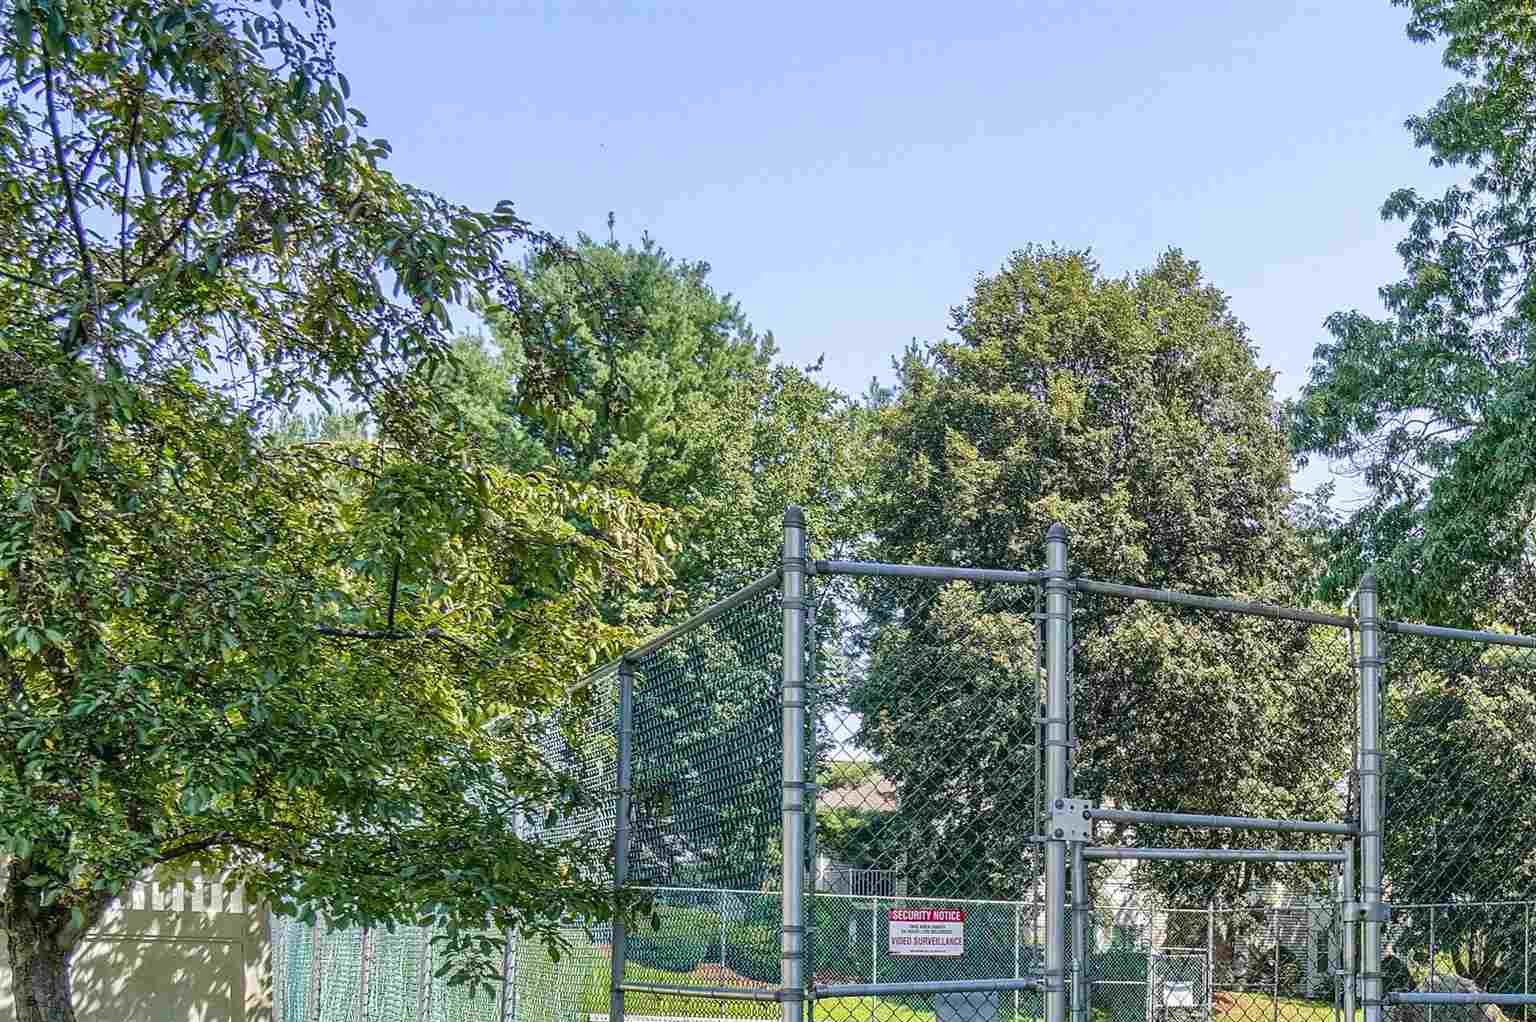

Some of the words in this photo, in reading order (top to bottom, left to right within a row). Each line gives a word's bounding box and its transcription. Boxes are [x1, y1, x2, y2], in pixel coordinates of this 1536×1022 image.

[892, 910, 931, 921] SECURITY
[933, 910, 961, 921] NOTICE
[891, 936, 912, 945] VIDEO
[912, 936, 962, 945] SURVEILLANCE
